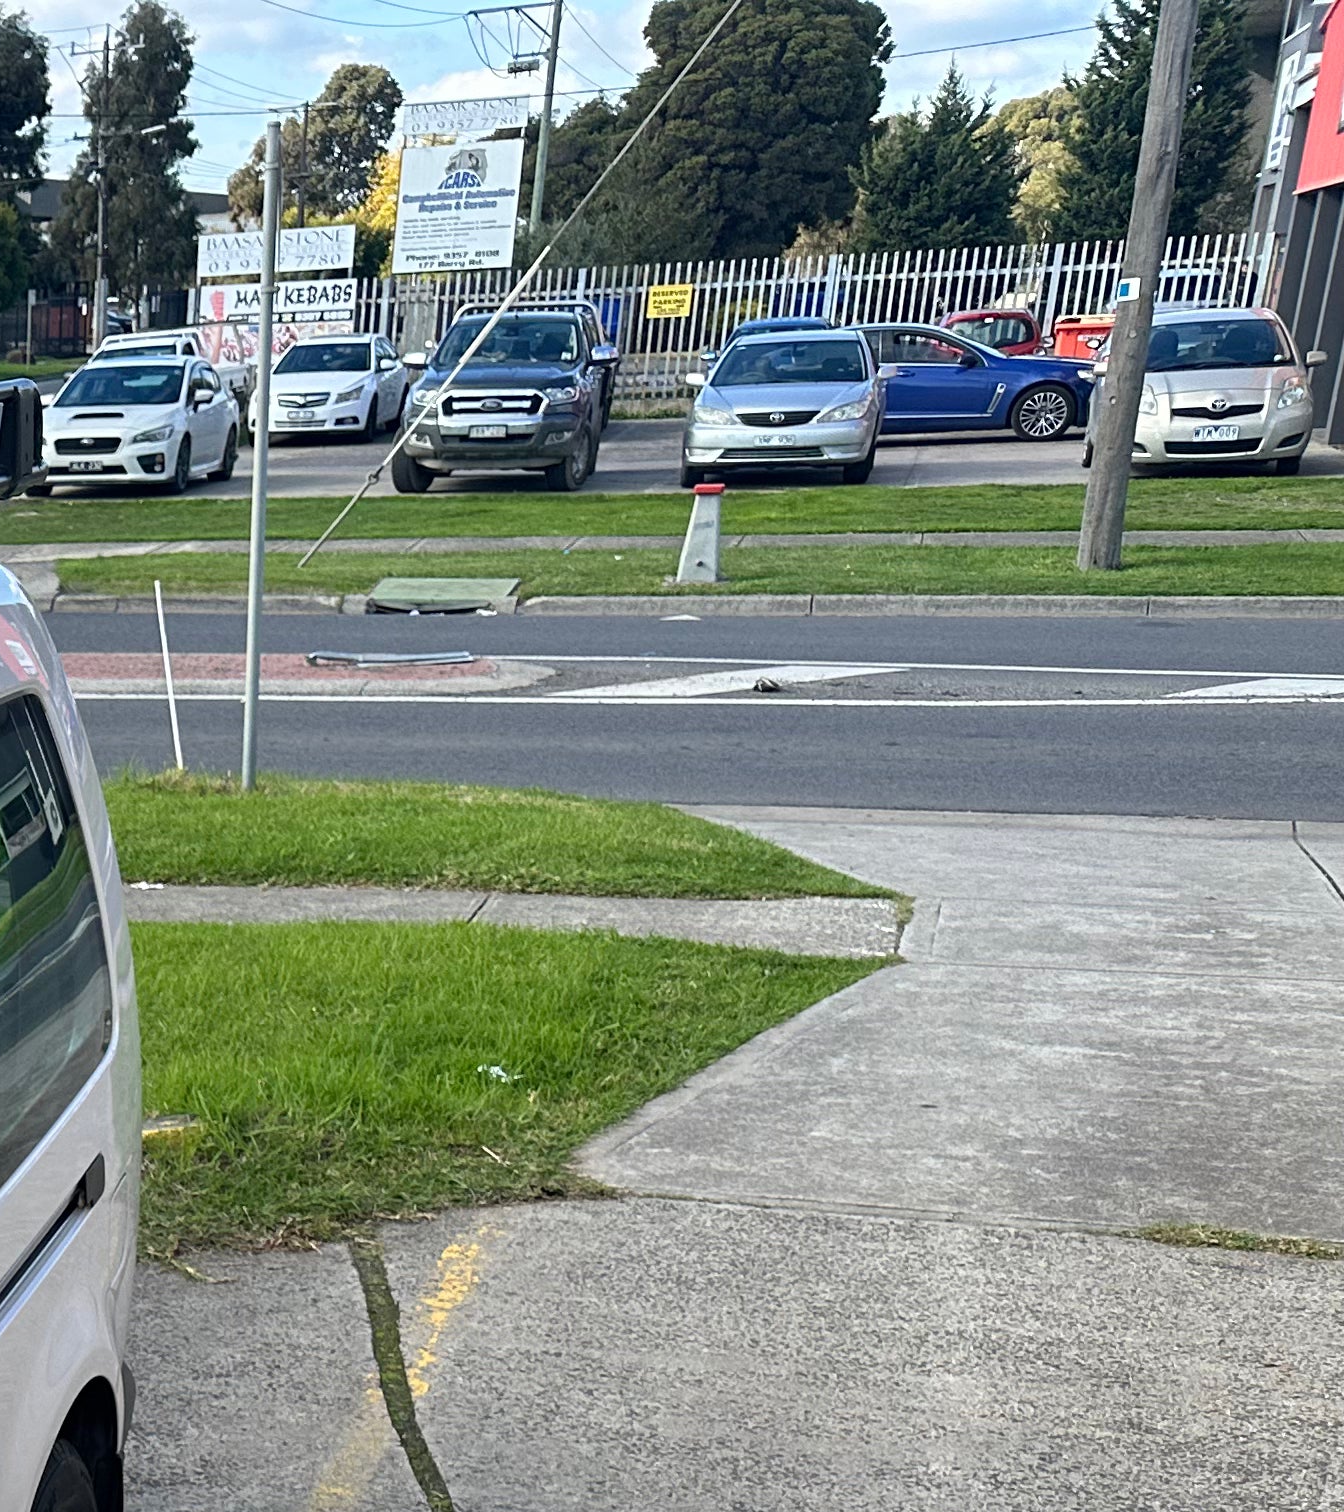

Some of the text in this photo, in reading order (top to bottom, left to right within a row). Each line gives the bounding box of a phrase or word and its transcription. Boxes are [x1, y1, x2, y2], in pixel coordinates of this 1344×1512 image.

[411, 122, 429, 133] 03
[480, 114, 519, 127] 7780
[206, 235, 264, 252] BAASA
[284, 228, 348, 246] STONE
[208, 260, 231, 274] 03
[295, 253, 342, 268] 7780
[284, 284, 353, 308] KEBABS
